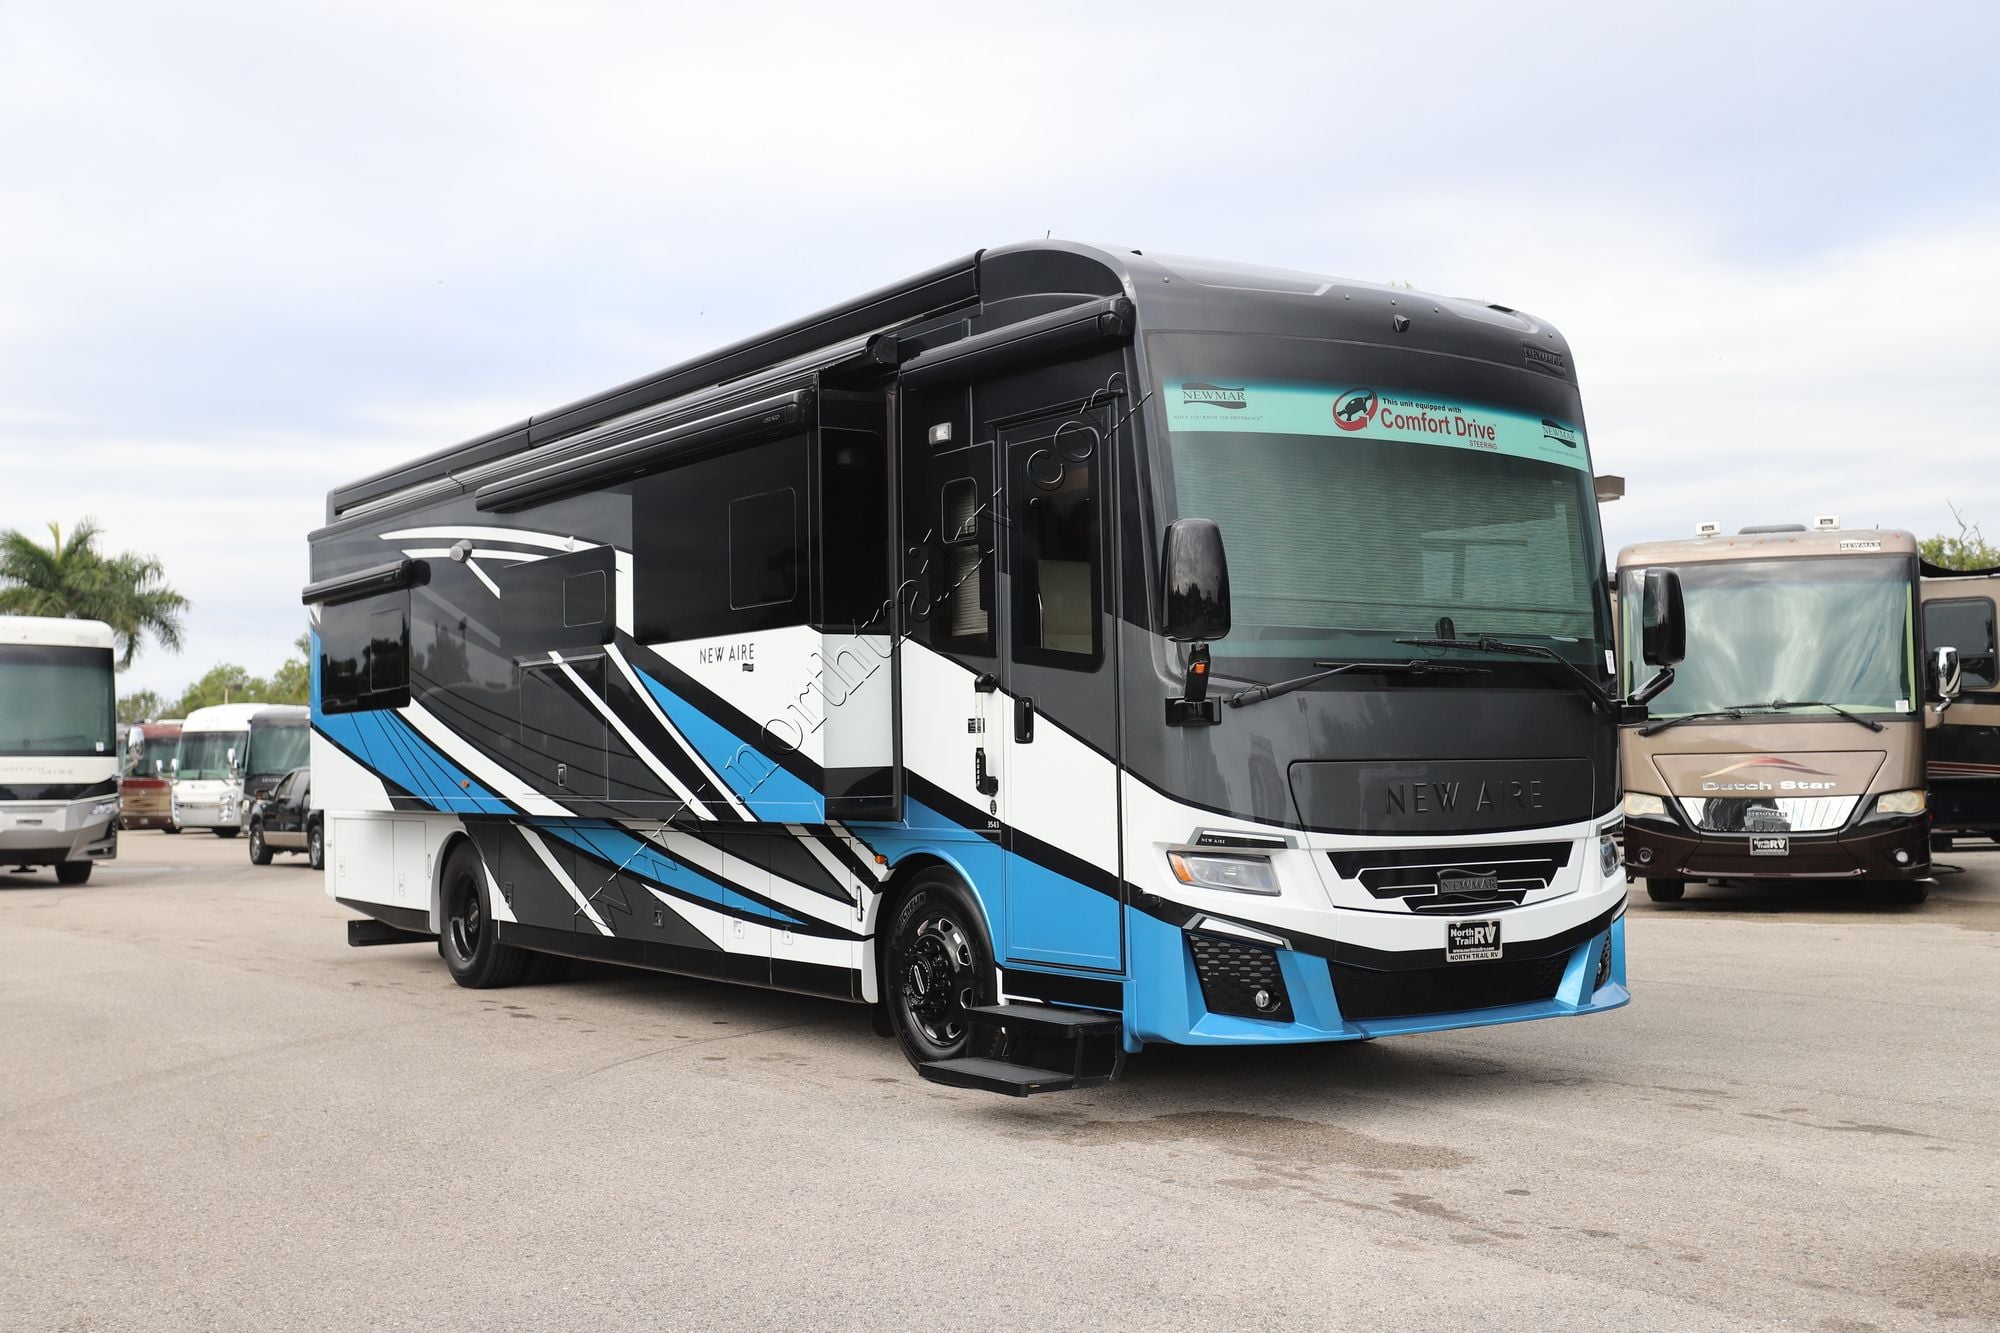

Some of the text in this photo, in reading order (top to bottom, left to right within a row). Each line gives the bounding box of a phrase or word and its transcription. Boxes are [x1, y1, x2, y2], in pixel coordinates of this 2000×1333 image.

[1183, 390, 1246, 401] NEWMAR
[1382, 397, 1398, 406] This
[1400, 400, 1414, 408] unit
[1415, 402, 1446, 412] equipped
[1380, 407, 1496, 441] Comfort Drive
[1542, 425, 1576, 441] NEWMAR
[1468, 439, 1498, 450] STEERING
[699, 643, 755, 665] NEW AIRE
[1702, 780, 1837, 791] Dutch Star
[1385, 779, 1544, 816] NEW AIRE
[987, 820, 1000, 829] 3543
[1769, 839, 1786, 849] RV
[1441, 878, 1497, 890] NEWMAR
[1450, 927, 1474, 937] North
[1474, 926, 1497, 945] RV
[1454, 936, 1474, 945] Trail
[1450, 952, 1471, 961] NORTH
[1472, 951, 1490, 959] TRAIL
